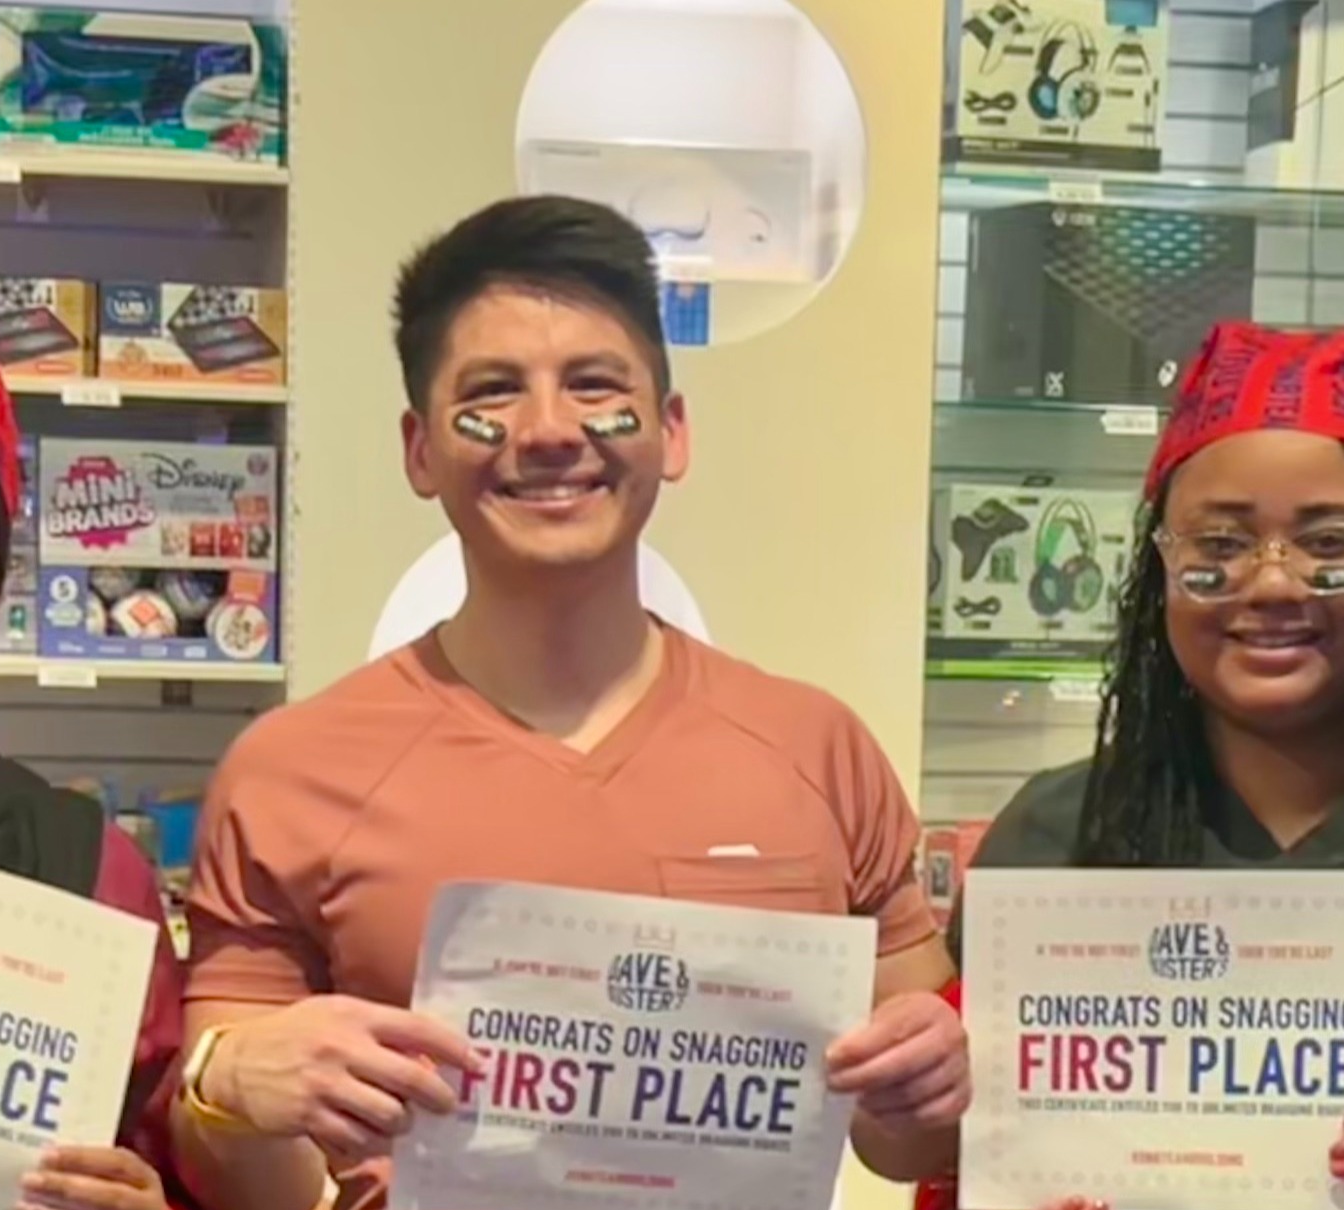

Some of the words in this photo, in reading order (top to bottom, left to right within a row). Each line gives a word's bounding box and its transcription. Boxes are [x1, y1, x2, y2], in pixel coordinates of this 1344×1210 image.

[47, 502, 154, 535] BRANDS
[466, 1009, 613, 1053] CONGRATS
[622, 1026, 660, 1058] ON
[669, 1030, 807, 1073] SNAGGING
[1020, 994, 1159, 1027] CONGRATS
[1172, 998, 1206, 1028] ON
[458, 1047, 614, 1117] FIRST
[630, 1065, 800, 1135] PLACE
[1019, 1033, 1165, 1093] FIRST
